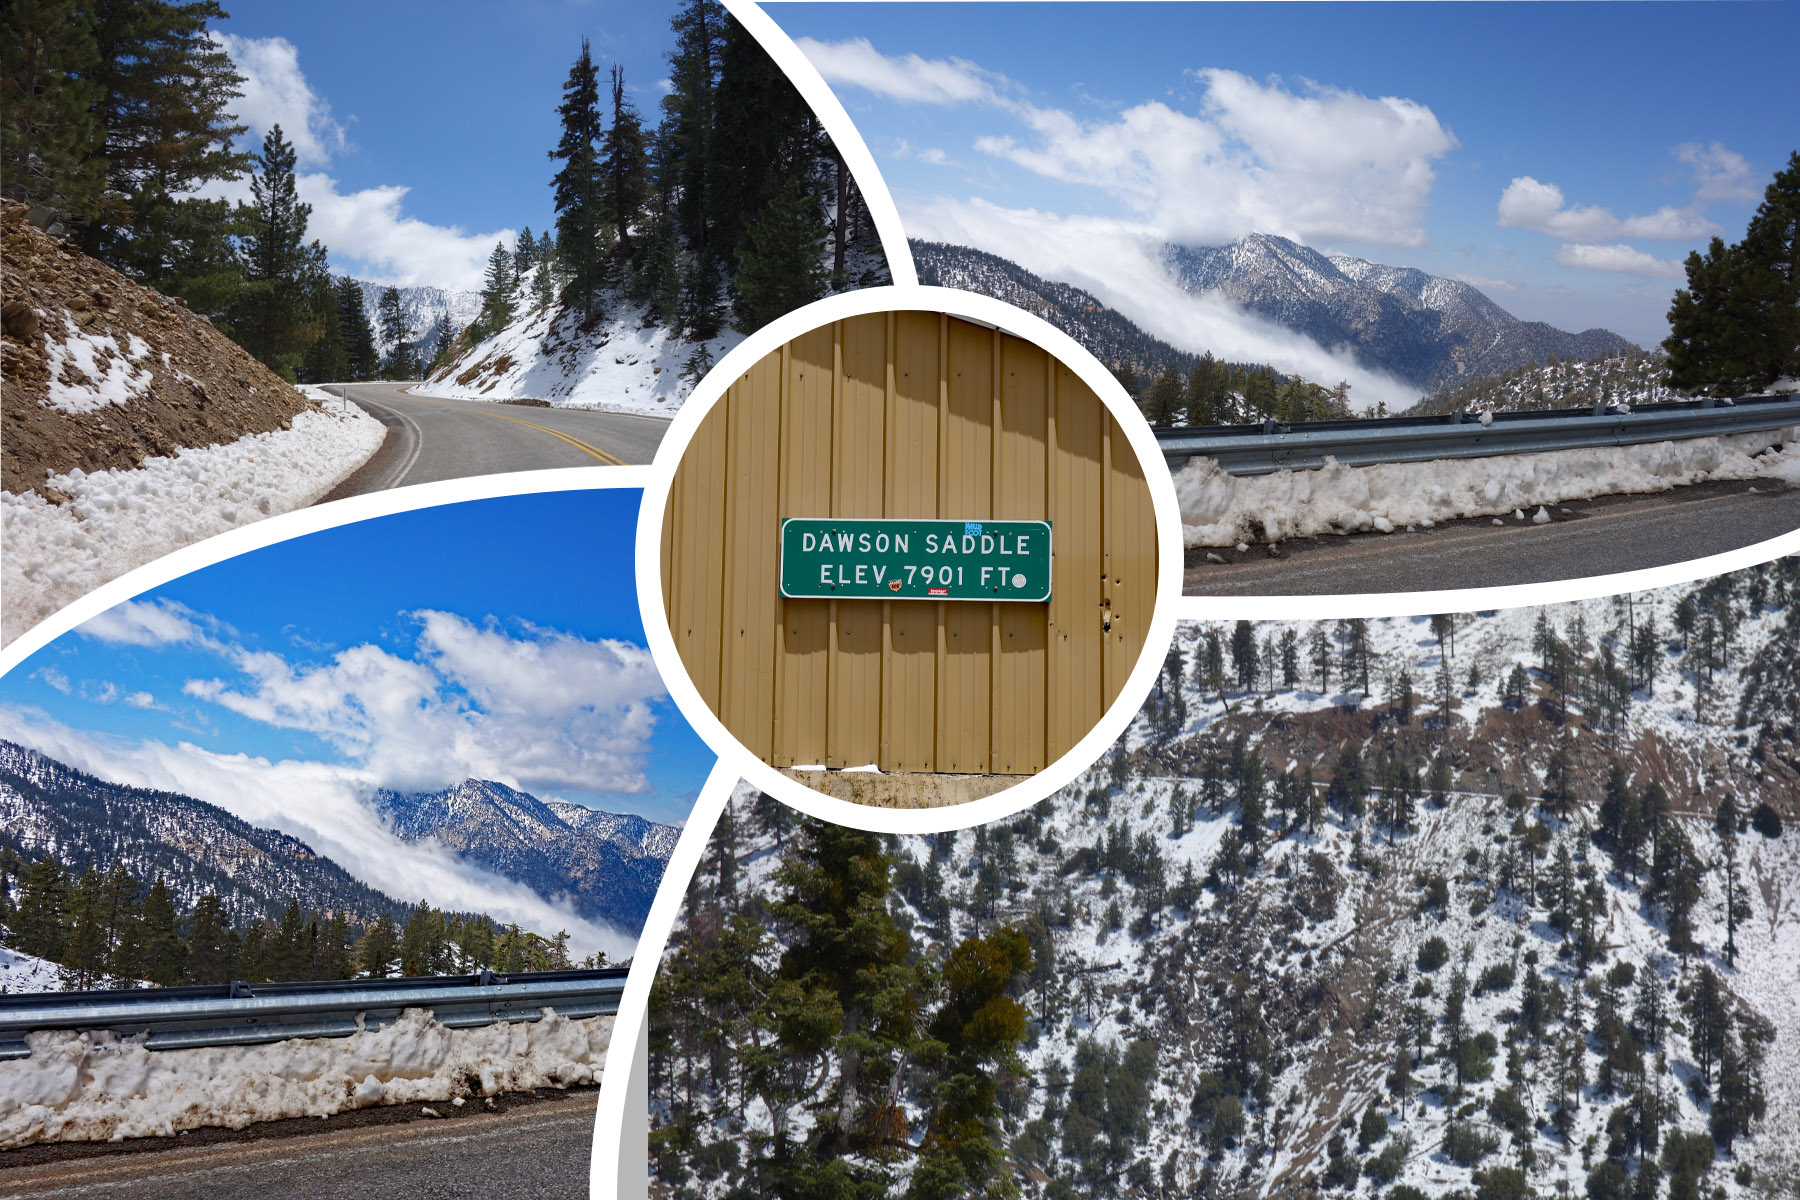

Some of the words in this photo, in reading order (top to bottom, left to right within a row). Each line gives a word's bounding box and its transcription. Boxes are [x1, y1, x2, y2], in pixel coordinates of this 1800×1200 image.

[803, 532, 909, 553] DAWSON
[925, 533, 1030, 555] SADDLE
[820, 564, 887, 585] ELEV
[904, 565, 963, 586] 7901
[981, 566, 1010, 587] FT
